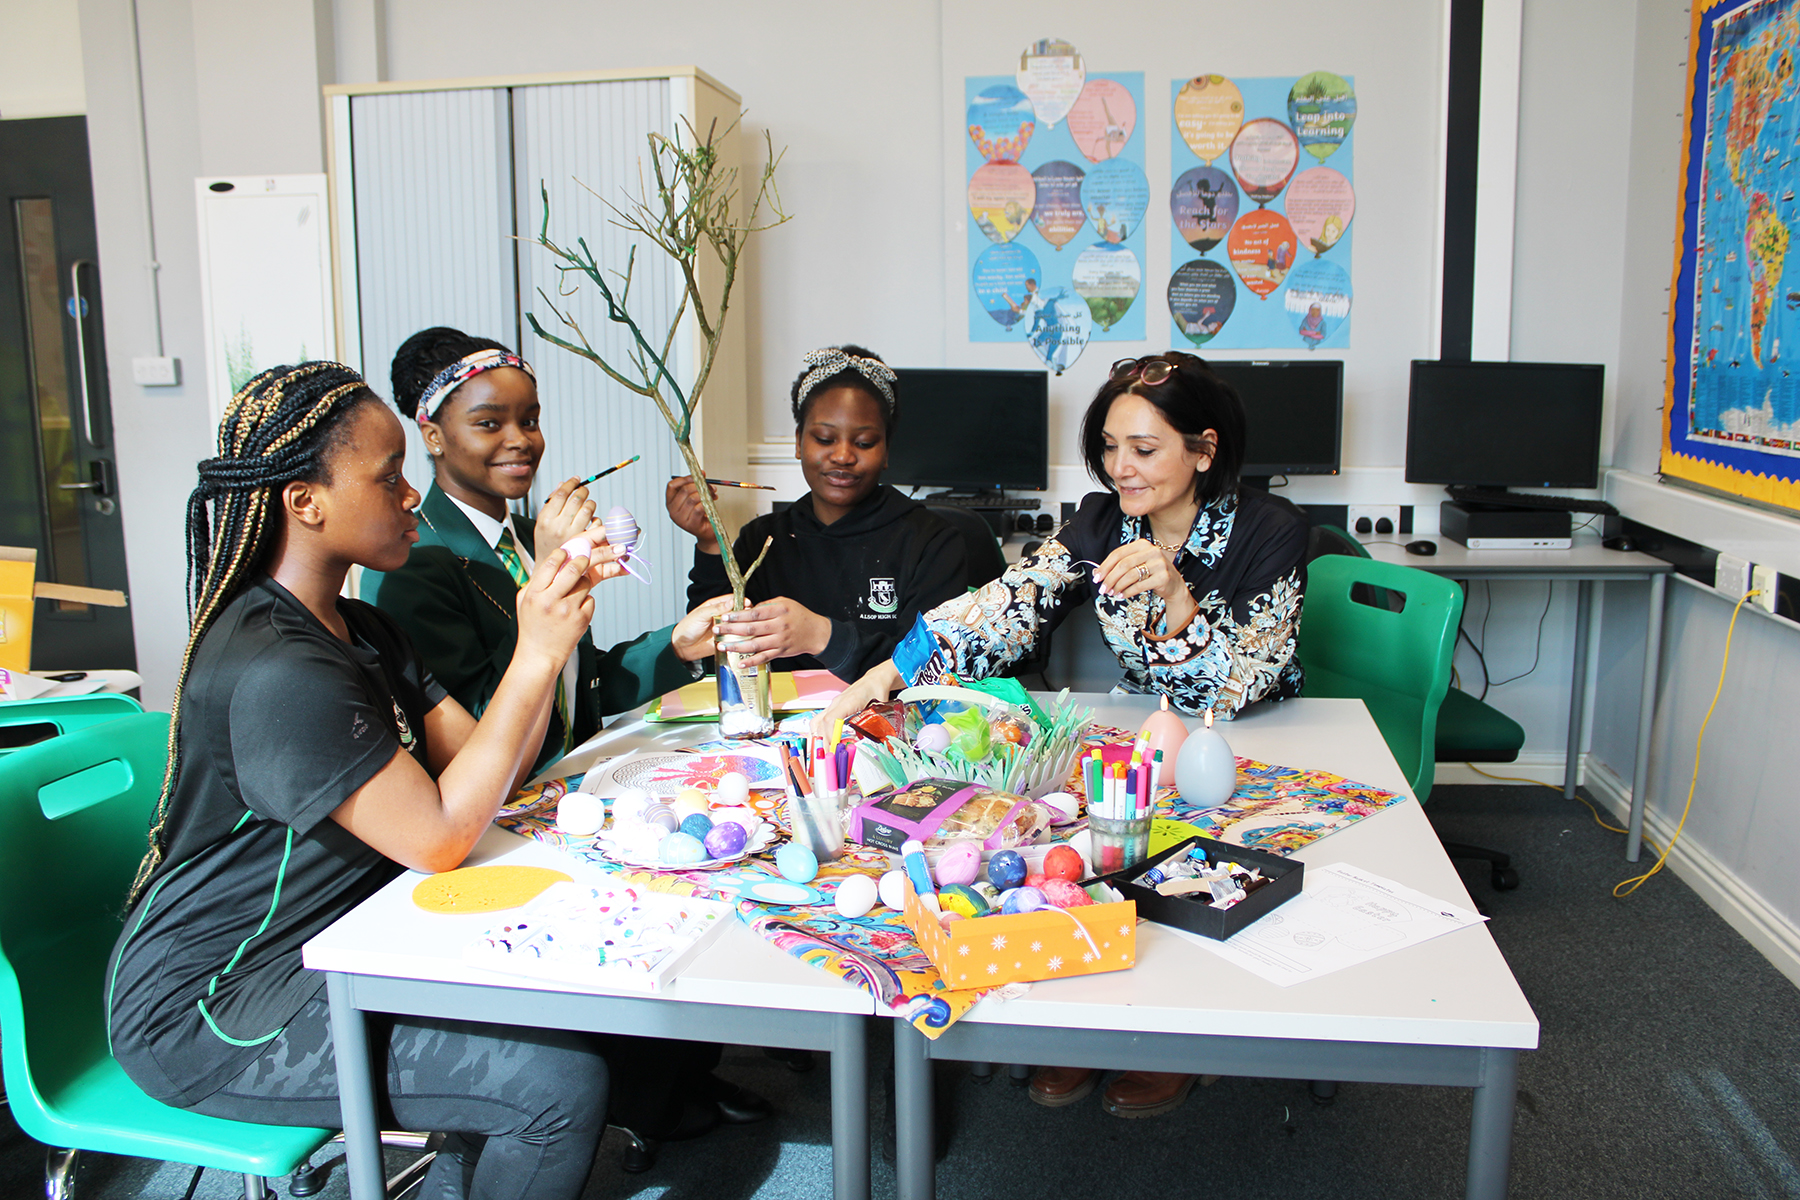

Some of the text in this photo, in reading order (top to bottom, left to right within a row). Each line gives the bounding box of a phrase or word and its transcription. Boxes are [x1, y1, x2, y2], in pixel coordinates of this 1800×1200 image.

[1295, 110, 1345, 124] Leap into
[1183, 130, 1195, 138] it's
[1196, 131, 1215, 140] going
[1225, 130, 1234, 138] be
[1297, 125, 1345, 138] Learning
[1189, 141, 1216, 150] worth
[1054, 209, 1071, 218] truly
[1179, 205, 1229, 218] Reach for
[1180, 218, 1227, 230] the Stars
[1263, 238, 1270, 246] of
[1036, 324, 1081, 335] Anything
[1033, 336, 1084, 346] Is Possible
[875, 840, 888, 848] CROSS
[1352, 905, 1391, 922] Easter
[1364, 901, 1400, 917] Happy
